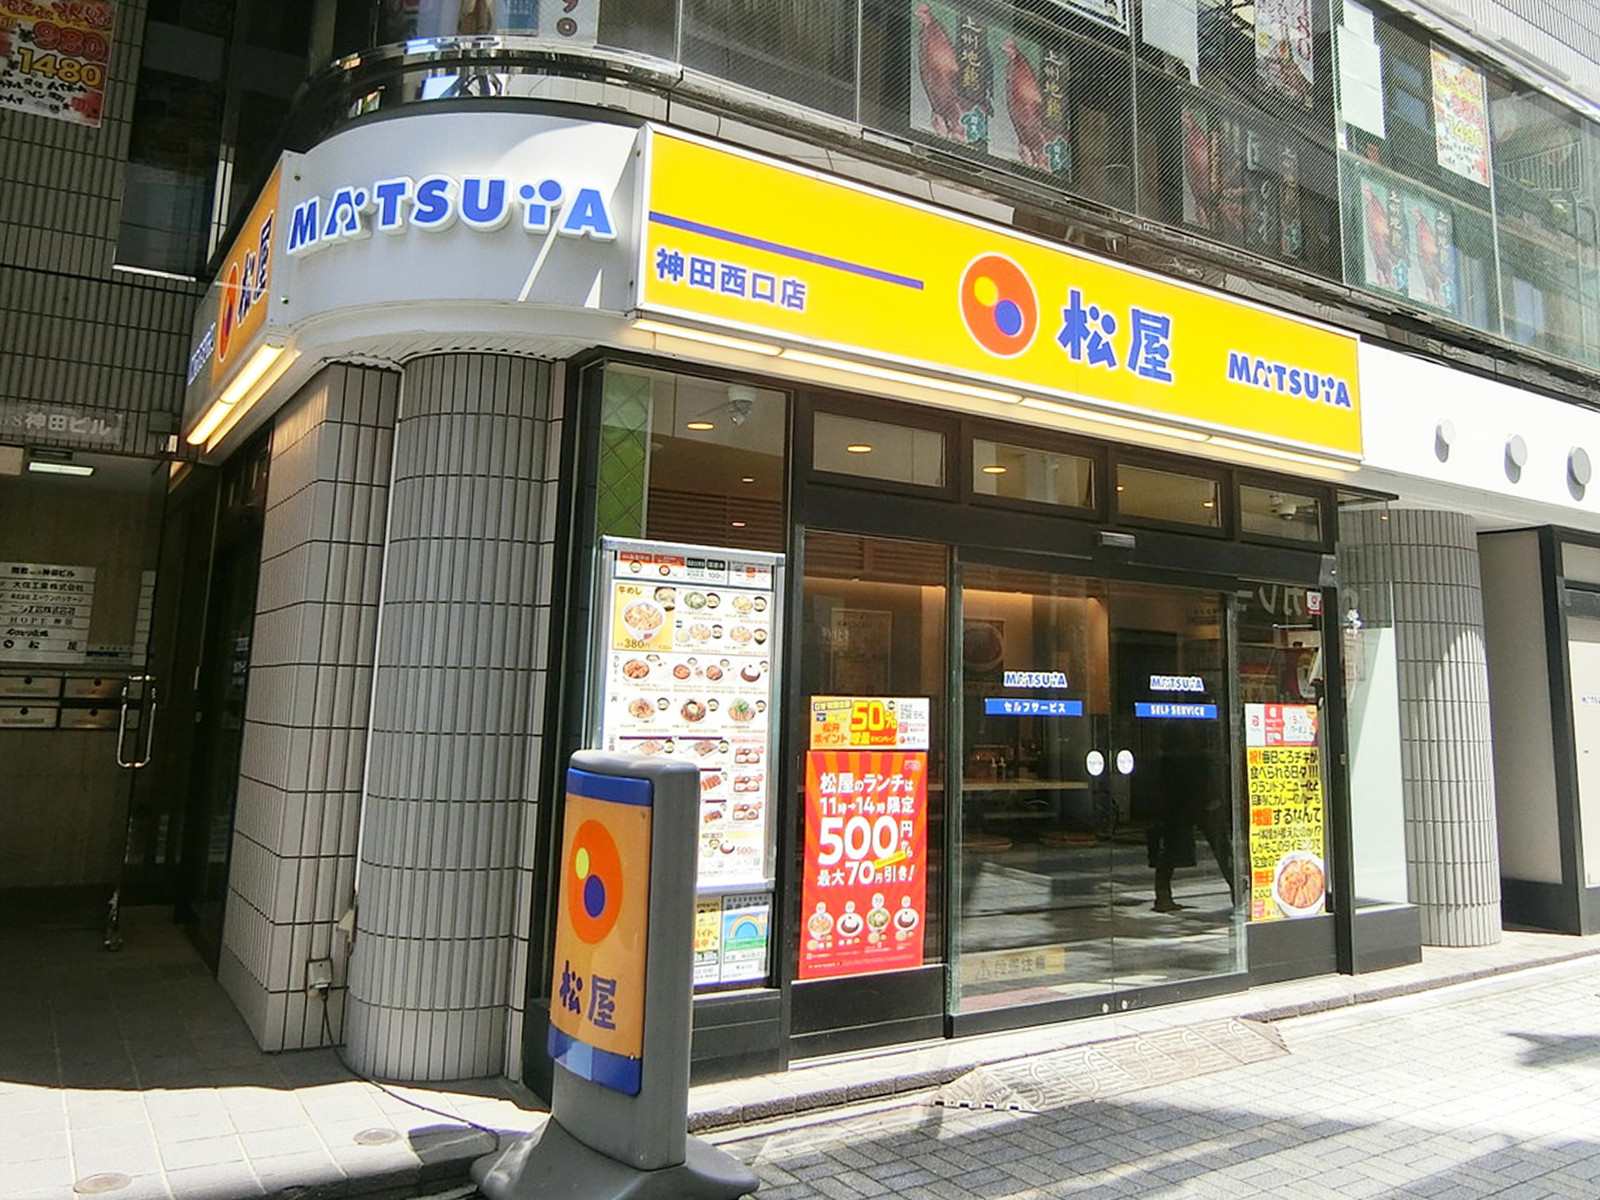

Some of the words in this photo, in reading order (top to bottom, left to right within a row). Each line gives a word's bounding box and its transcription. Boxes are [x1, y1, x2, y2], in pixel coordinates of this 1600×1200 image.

[287, 176, 614, 253] MATSUYA
[236, 208, 274, 329] 松屋
[655, 247, 806, 311] 神田西口店
[1056, 289, 1174, 383] 松屋
[1227, 351, 1352, 408] MATSUYA
[1003, 702, 1067, 713] セルフサービス
[1004, 671, 1068, 687] MATSUYA
[1150, 676, 1205, 691] MATSUYA
[1151, 703, 1170, 715] SELF
[1171, 704, 1205, 717] SERVICE
[819, 772, 914, 794] 松屋のランチは
[558, 960, 618, 1031] 松屋
